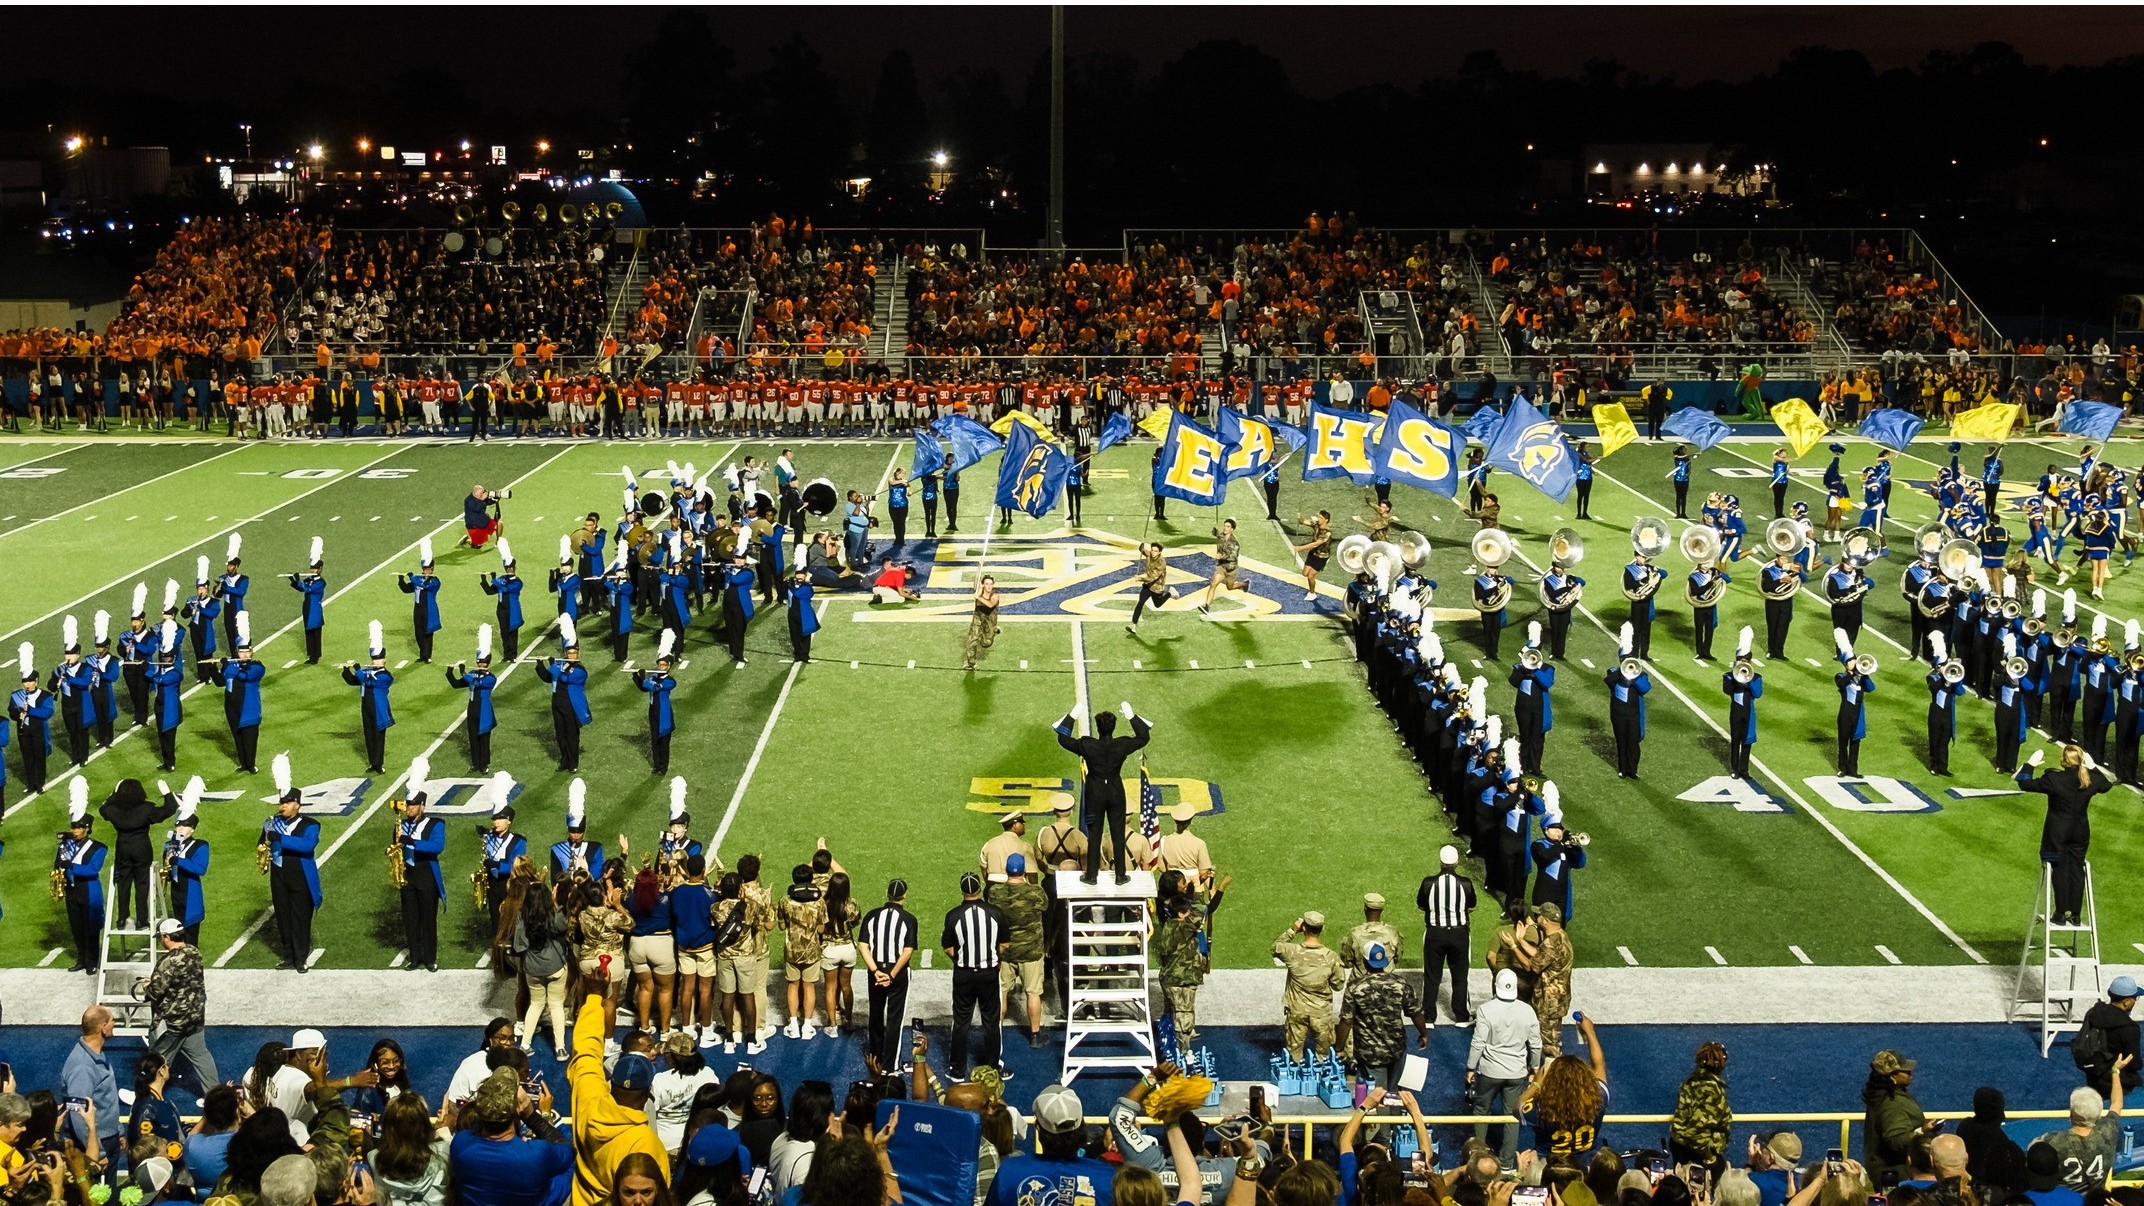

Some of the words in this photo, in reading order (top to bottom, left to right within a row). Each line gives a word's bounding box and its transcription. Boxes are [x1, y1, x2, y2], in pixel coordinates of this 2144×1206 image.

[425, 386, 434, 396] 71
[447, 387, 455, 397] 47
[551, 386, 561, 397] 73
[896, 387, 906, 397] 22
[940, 390, 949, 400] 90
[981, 390, 990, 400] 72
[1074, 395, 1081, 405] 9
[1226, 417, 1275, 472] A
[1307, 411, 1377, 475] H
[1386, 418, 1451, 482] S
[1164, 423, 1226, 497] E
[965, 776, 1226, 816] 50
[1674, 774, 1943, 815] 40
[1551, 1124, 1595, 1154] 20
[2063, 1154, 2104, 1183] 24
